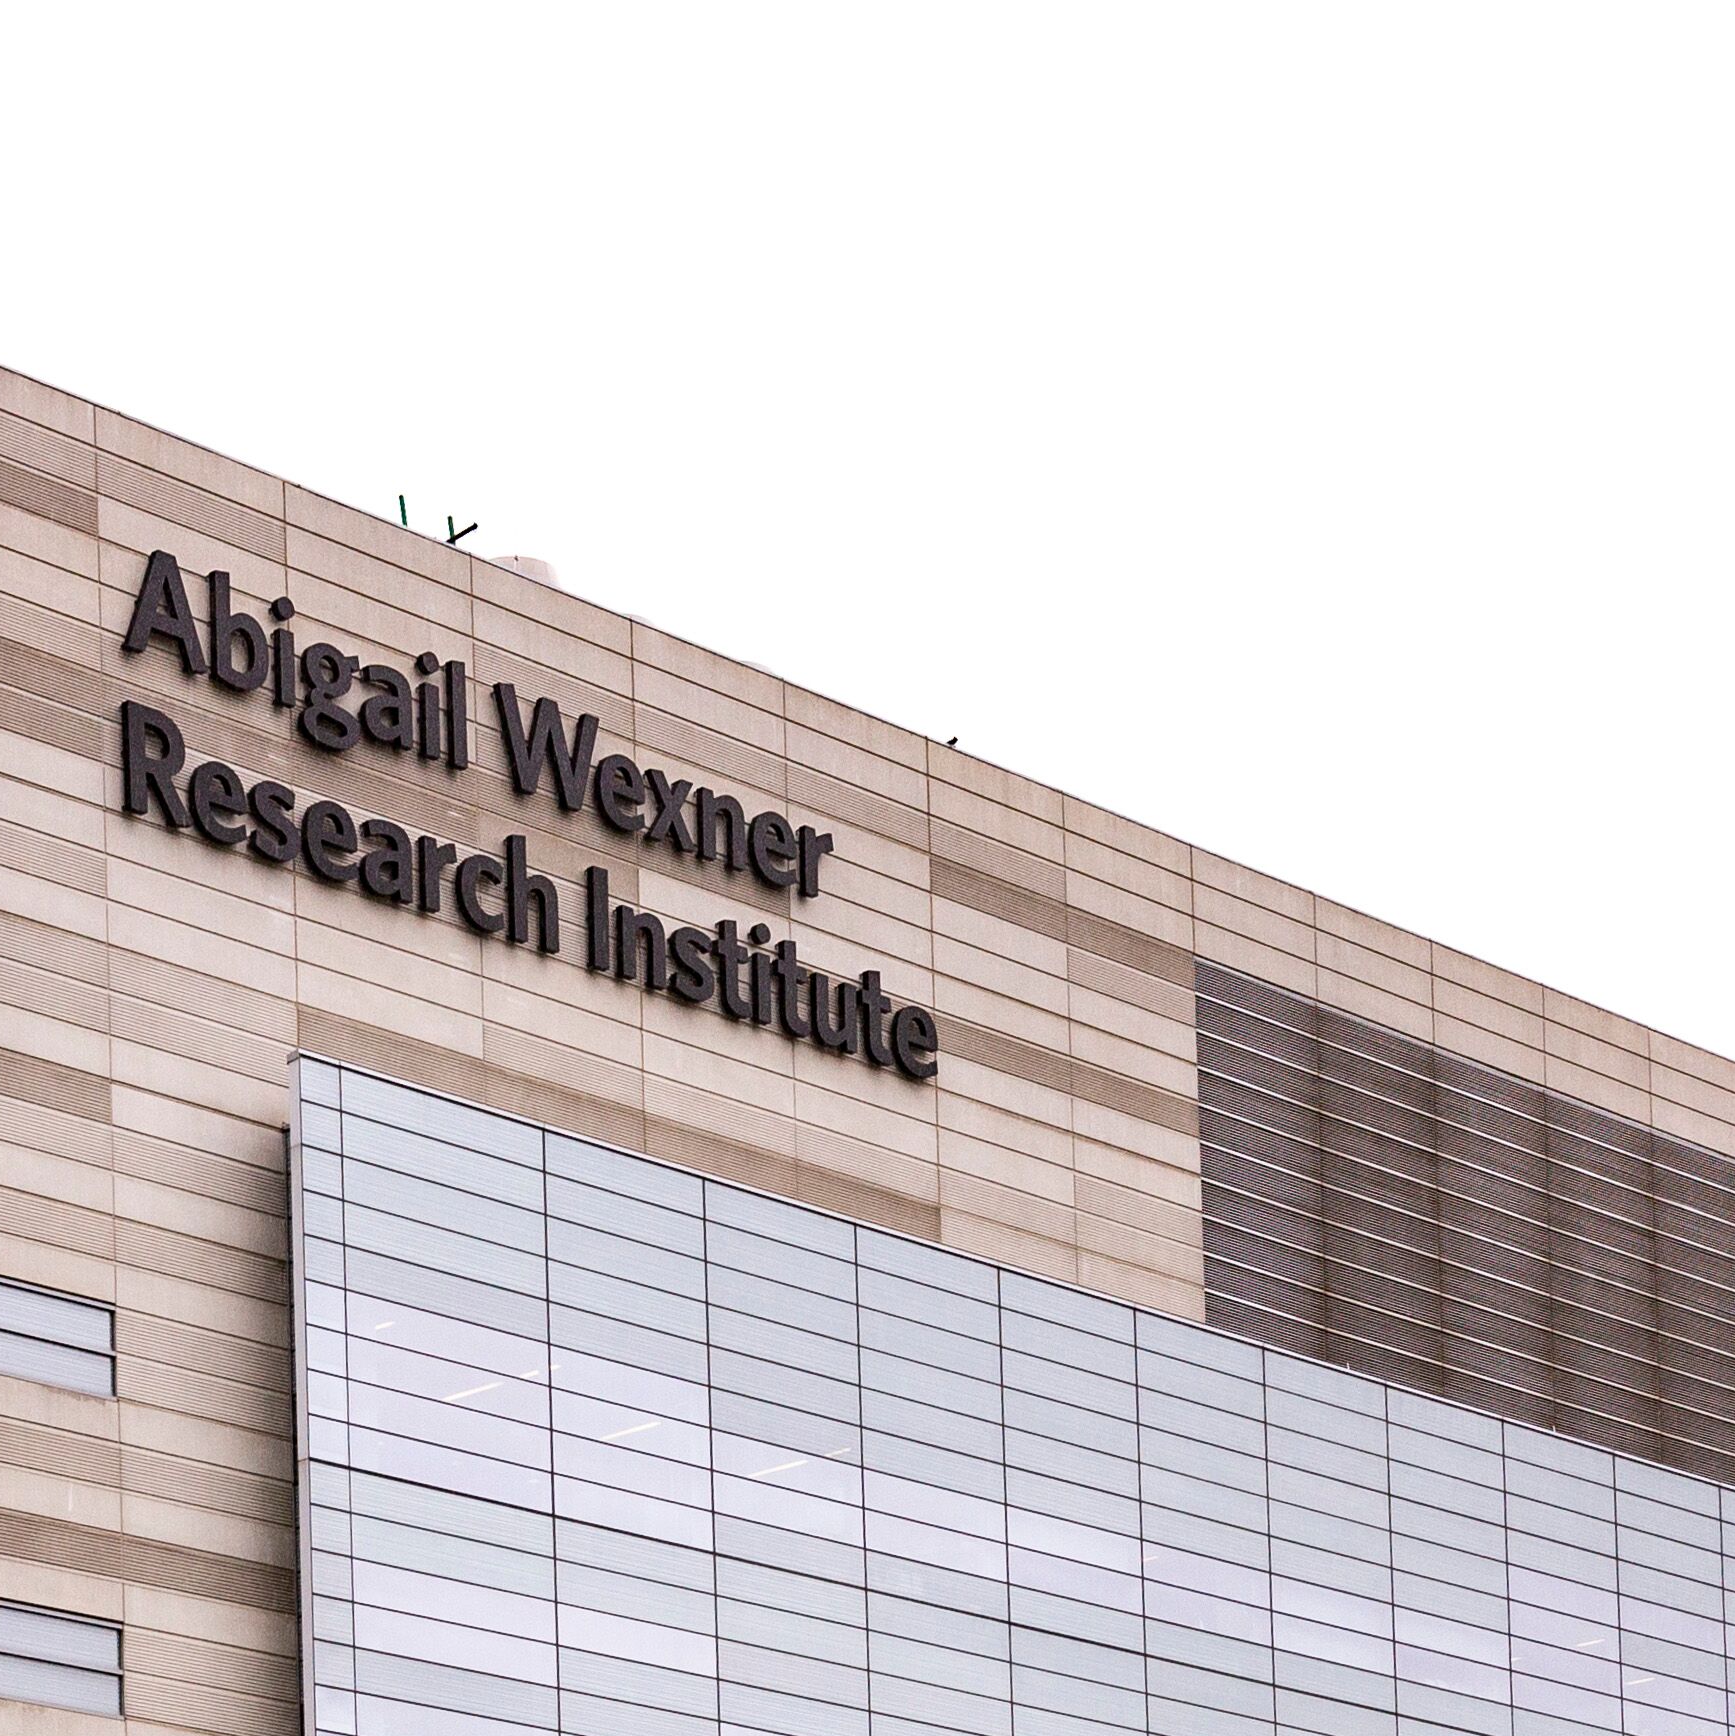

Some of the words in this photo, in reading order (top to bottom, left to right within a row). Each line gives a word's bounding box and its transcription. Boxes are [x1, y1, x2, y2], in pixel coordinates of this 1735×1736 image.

[122, 549, 467, 770] Abigail
[493, 683, 833, 899] Wexner
[122, 700, 560, 954] Research
[587, 866, 939, 1080] Institute
